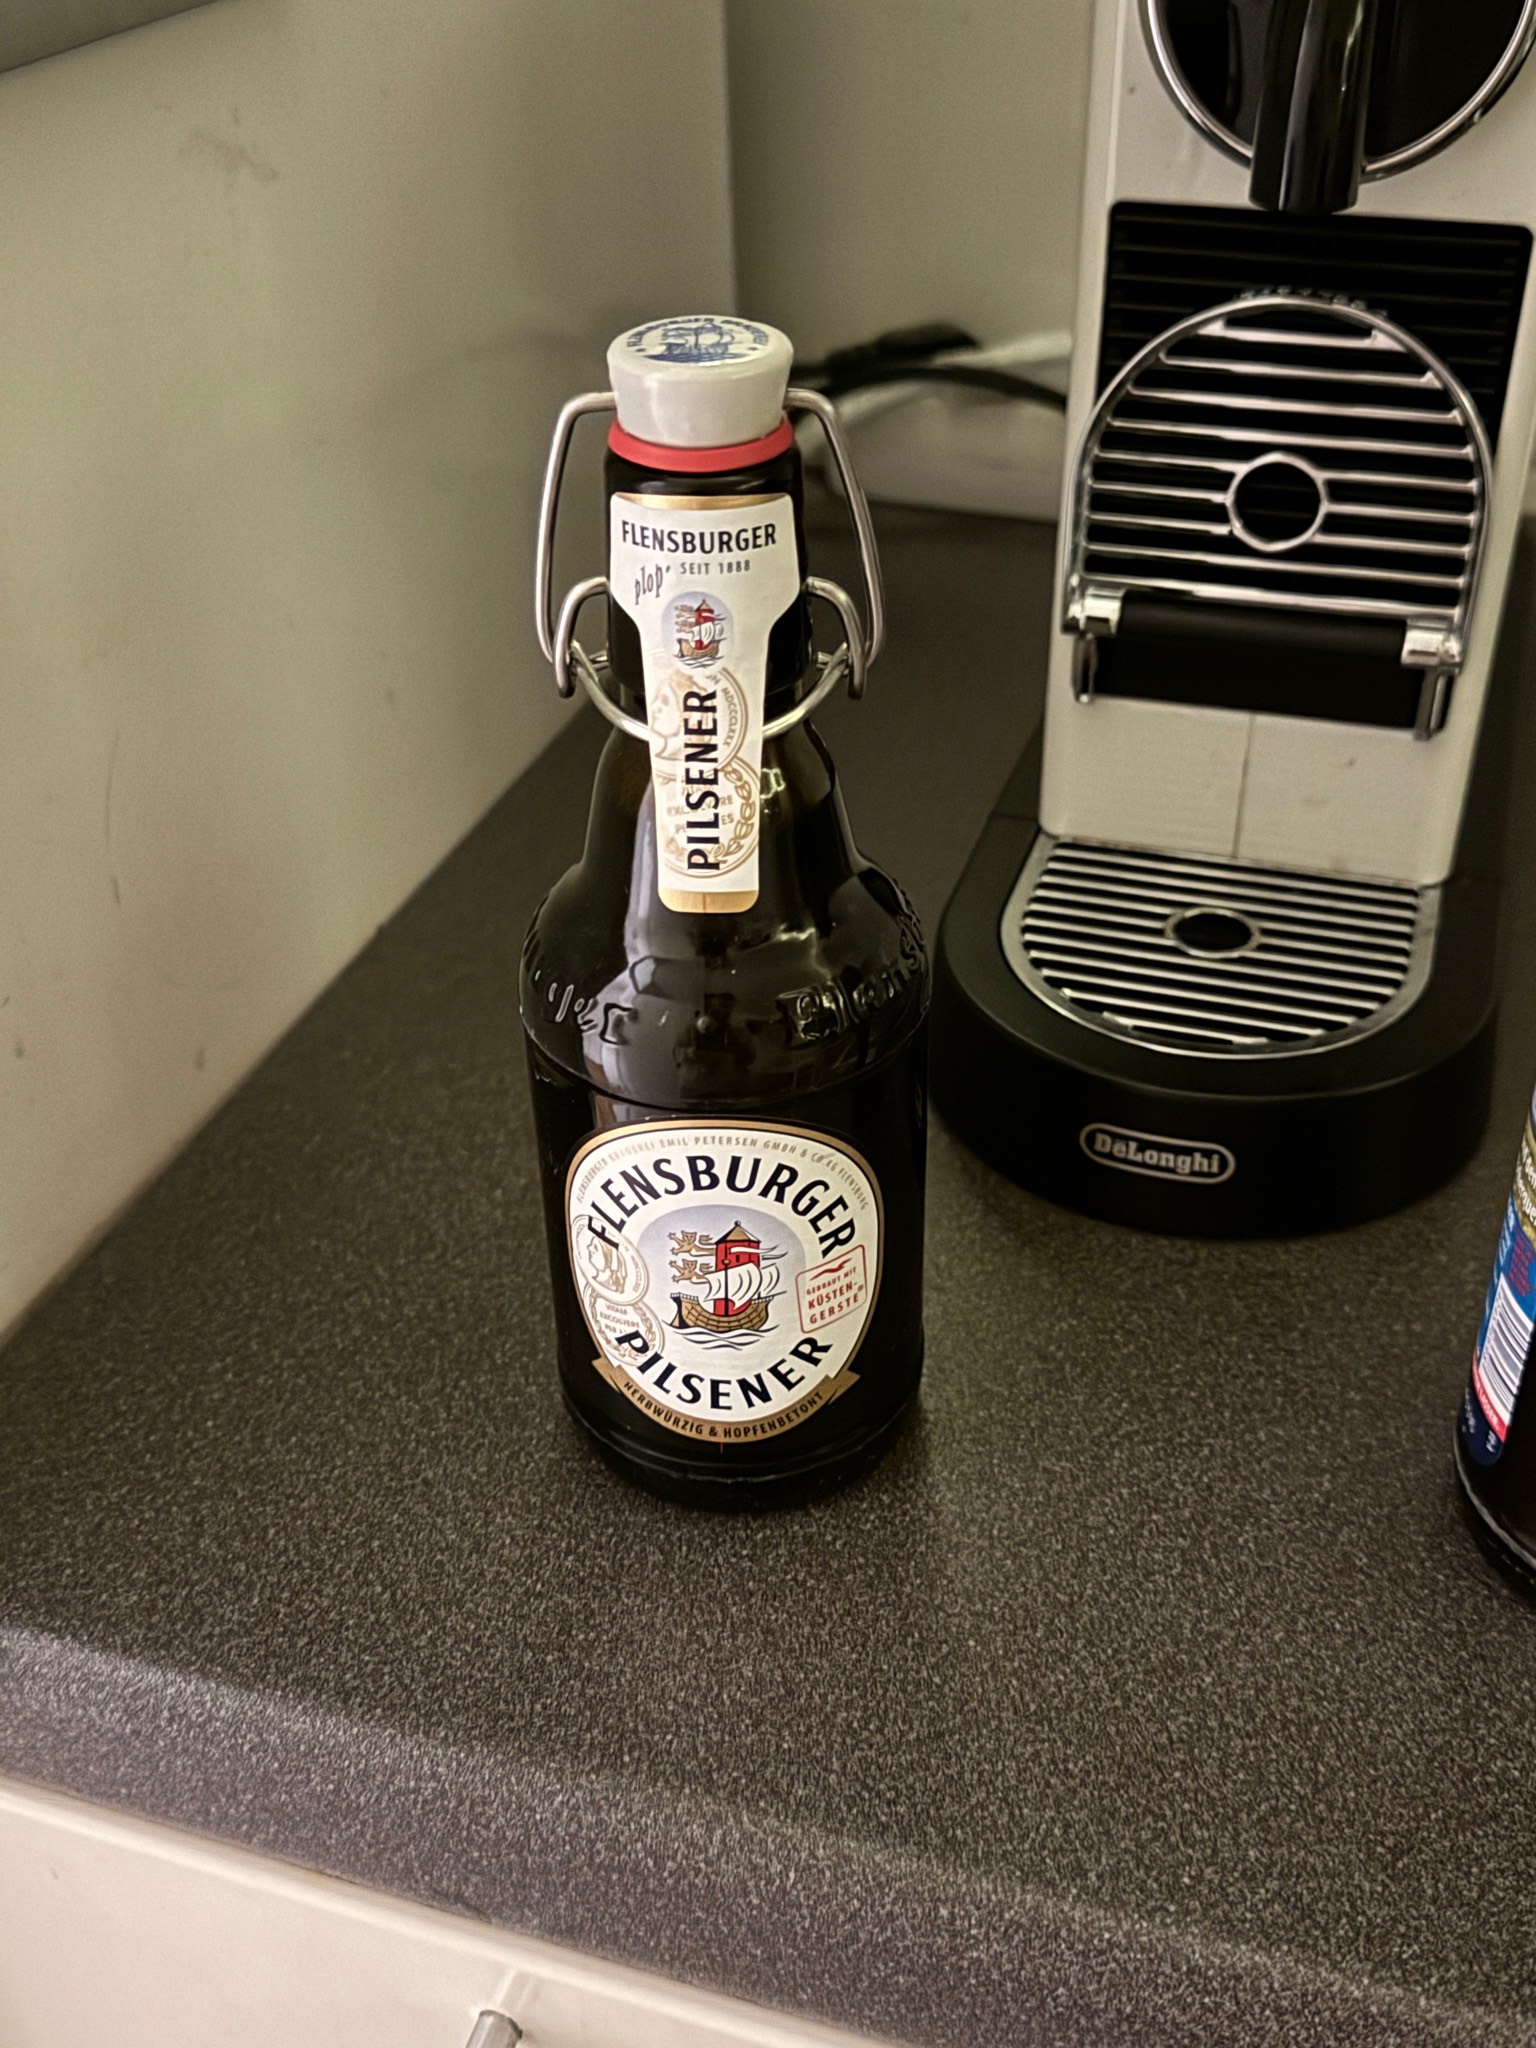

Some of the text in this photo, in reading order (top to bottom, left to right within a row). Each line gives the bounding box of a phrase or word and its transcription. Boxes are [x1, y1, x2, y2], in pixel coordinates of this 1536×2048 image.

[622, 520, 776, 554] FLENSBURGER
[680, 562, 710, 575] SEIT
[719, 560, 750, 574] 1888
[683, 690, 720, 871] PILSENER
[660, 1136, 688, 1148] EMIL
[694, 1134, 758, 1147] PETERSEN
[763, 1140, 798, 1154] GMBH
[800, 1148, 808, 1158] &
[837, 1168, 869, 1211] FLENSBURG
[587, 1155, 857, 1257] FLENSBURGER
[806, 1267, 857, 1296] GEBRAUT MIT
[808, 1280, 858, 1310] KÜSTEN-
[615, 1330, 833, 1411] PILSENER
[624, 1381, 825, 1439] HERBWÜRZIG & HOPFENBETONT
